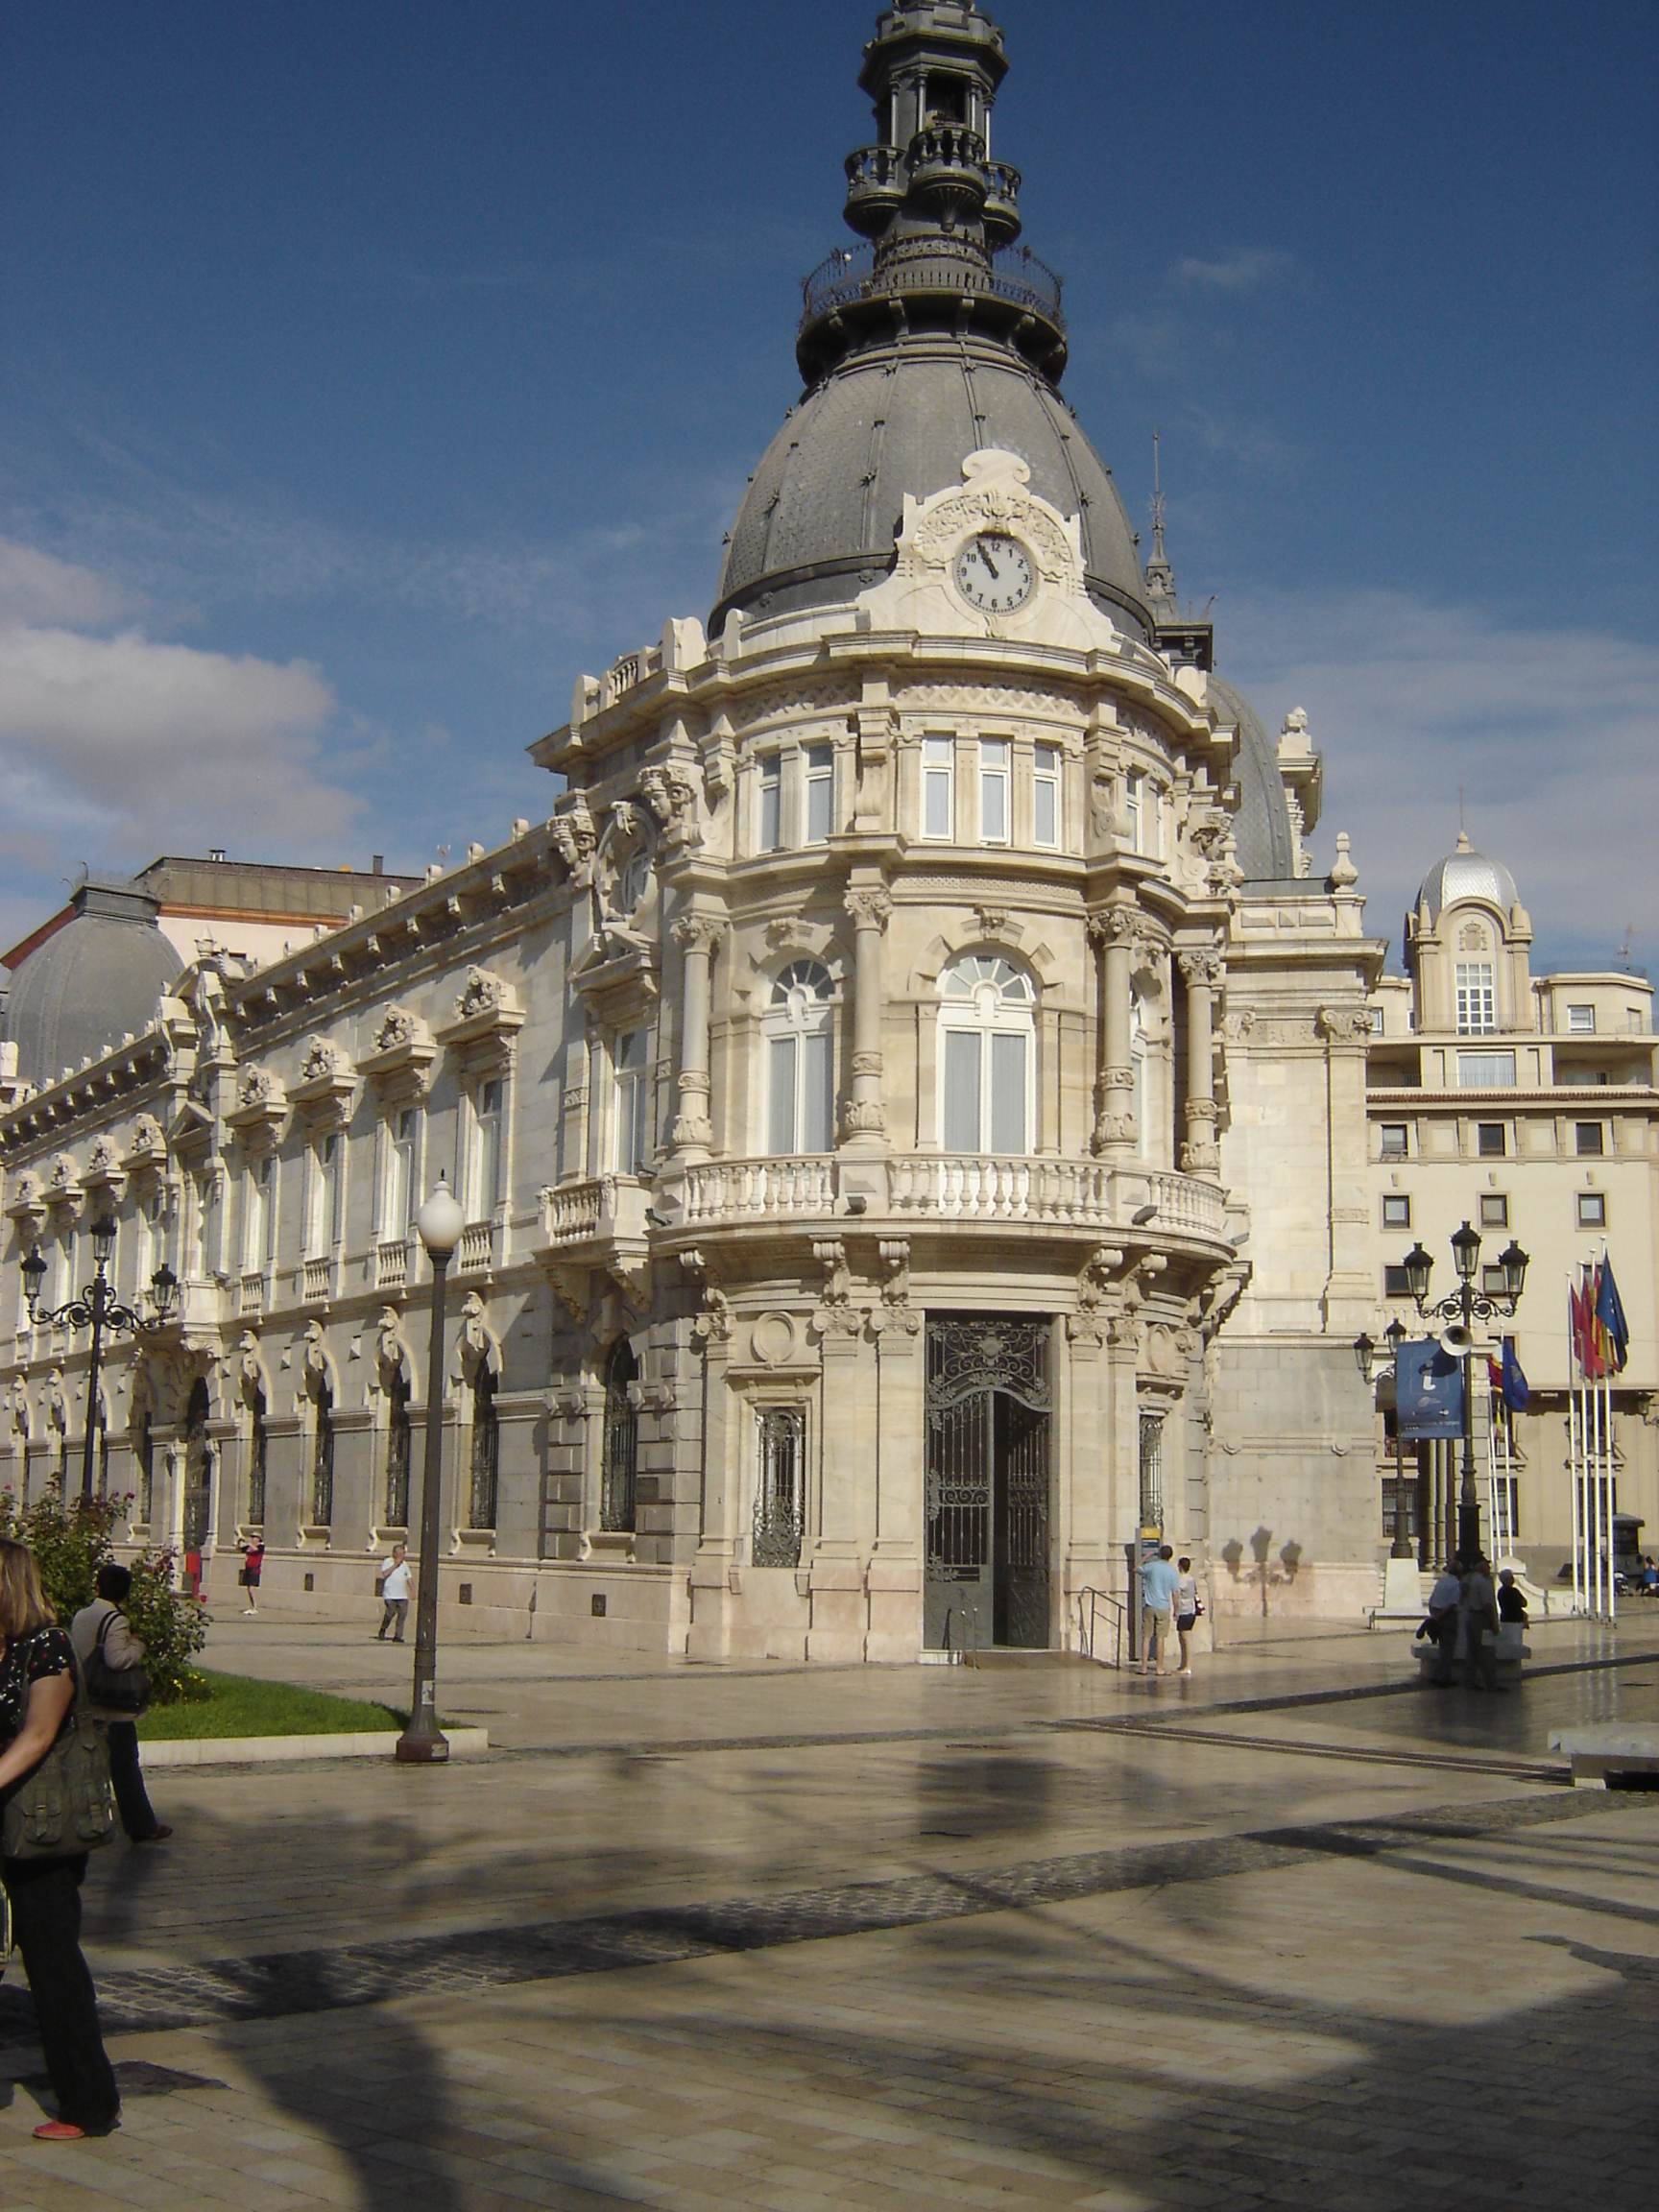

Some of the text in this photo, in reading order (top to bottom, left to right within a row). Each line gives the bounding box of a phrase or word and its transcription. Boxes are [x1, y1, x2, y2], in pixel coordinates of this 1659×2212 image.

[991, 542, 1000, 552] 12
[966, 553, 976, 563] 10
[1008, 548, 1013, 558] 1
[1018, 559, 1023, 568] 2
[961, 567, 967, 576] 9
[1022, 574, 1028, 583] 3
[966, 583, 972, 592] 8
[978, 593, 984, 603] 7
[1017, 589, 1022, 598] 4
[991, 598, 998, 608] 6
[1007, 596, 1013, 606] 5
